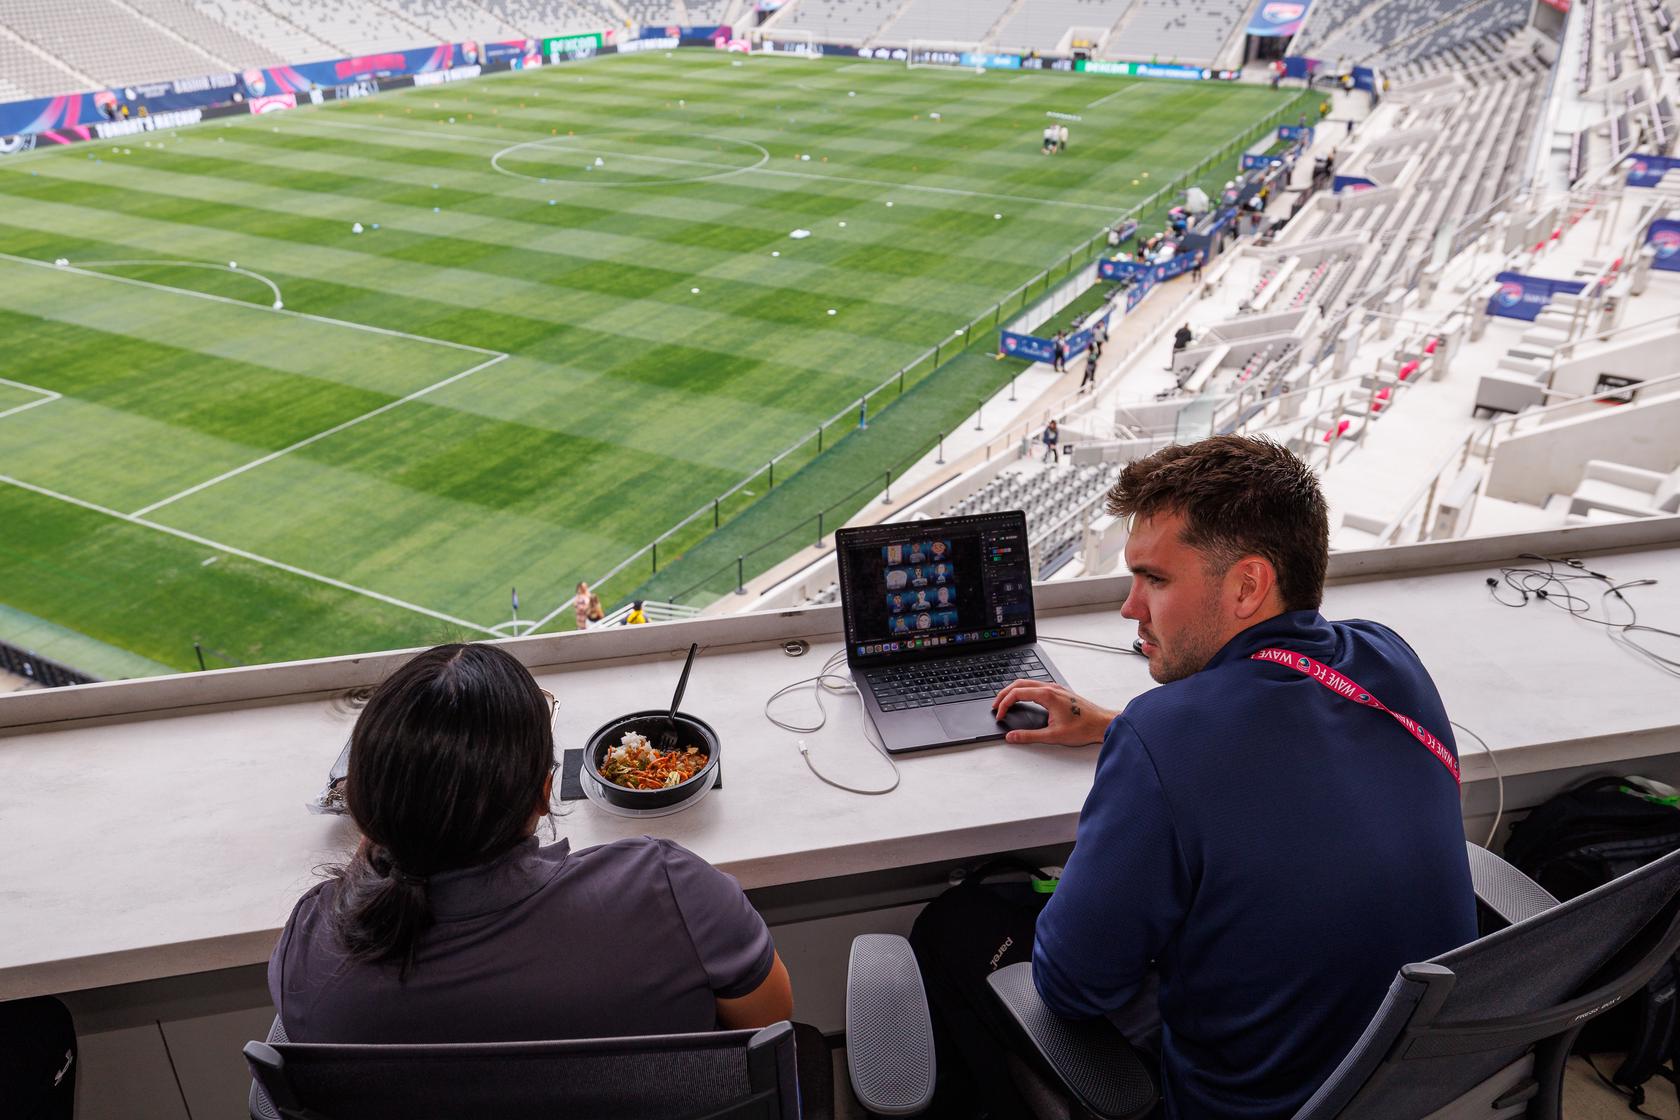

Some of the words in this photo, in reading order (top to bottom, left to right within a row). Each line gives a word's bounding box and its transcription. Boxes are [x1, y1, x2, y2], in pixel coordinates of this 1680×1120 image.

[1258, 650, 1292, 665] WAVE
[1313, 664, 1327, 681] FC
[1326, 672, 1356, 697] WAVE
[1427, 734, 1436, 750] FC
[1436, 742, 1453, 768] WAVE
